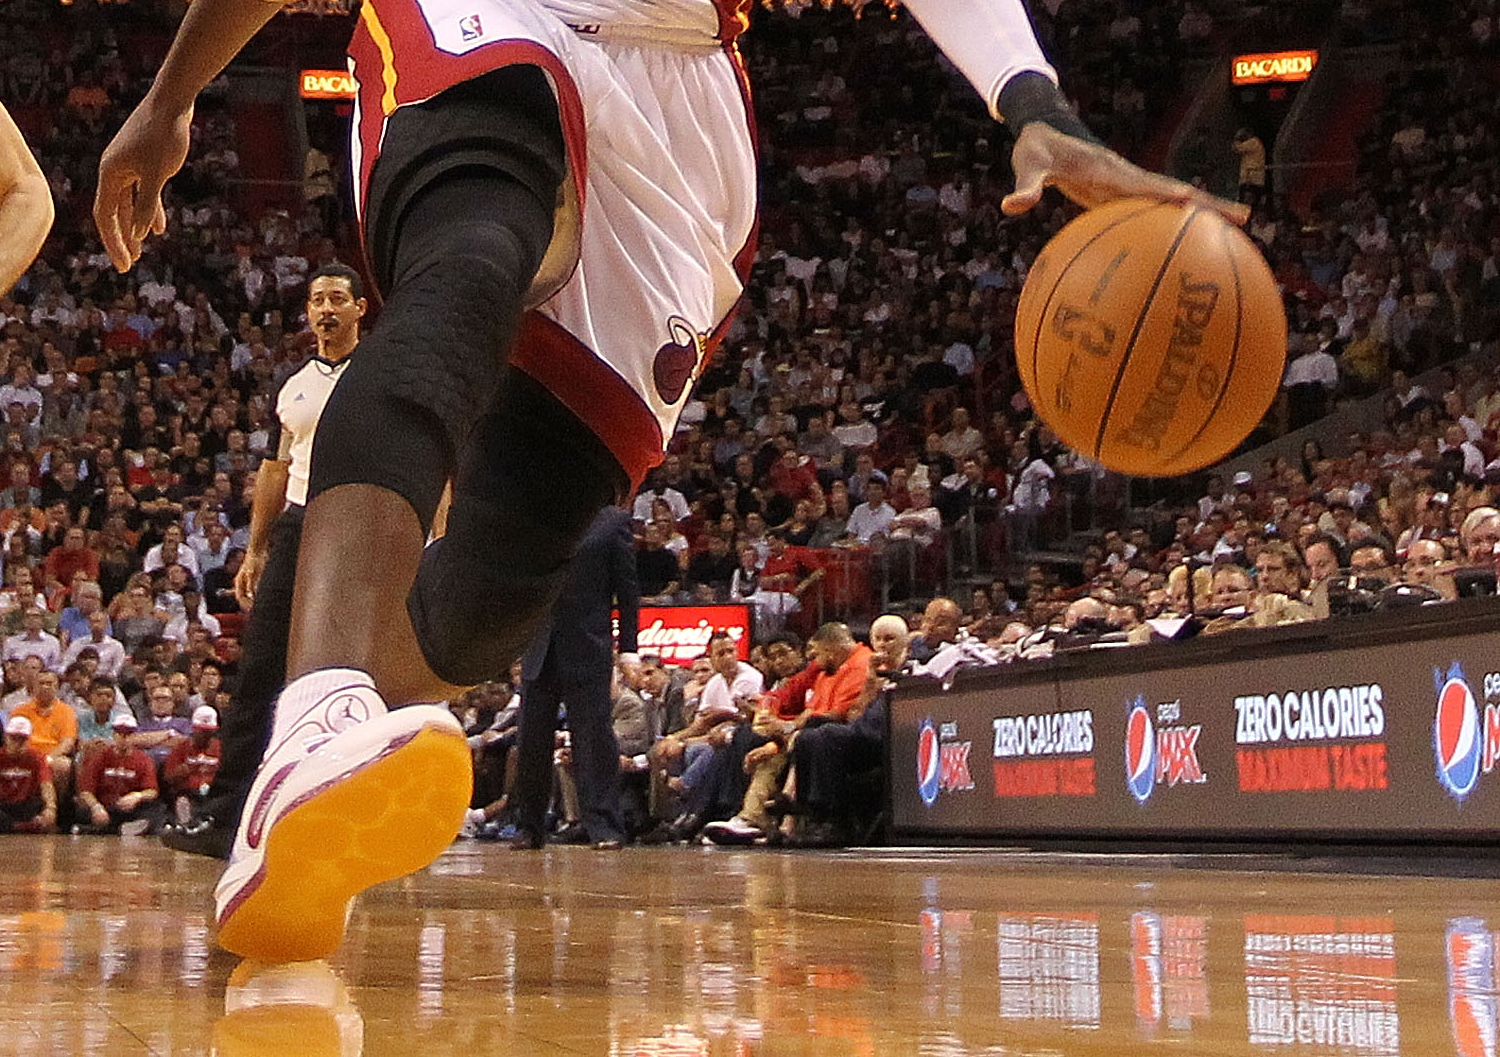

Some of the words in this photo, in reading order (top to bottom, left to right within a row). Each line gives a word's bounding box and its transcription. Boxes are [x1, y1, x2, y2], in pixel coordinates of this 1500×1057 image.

[1235, 56, 1313, 78] BACARDI
[1233, 693, 1283, 743] ZERO
[1283, 684, 1385, 740] CALORIES
